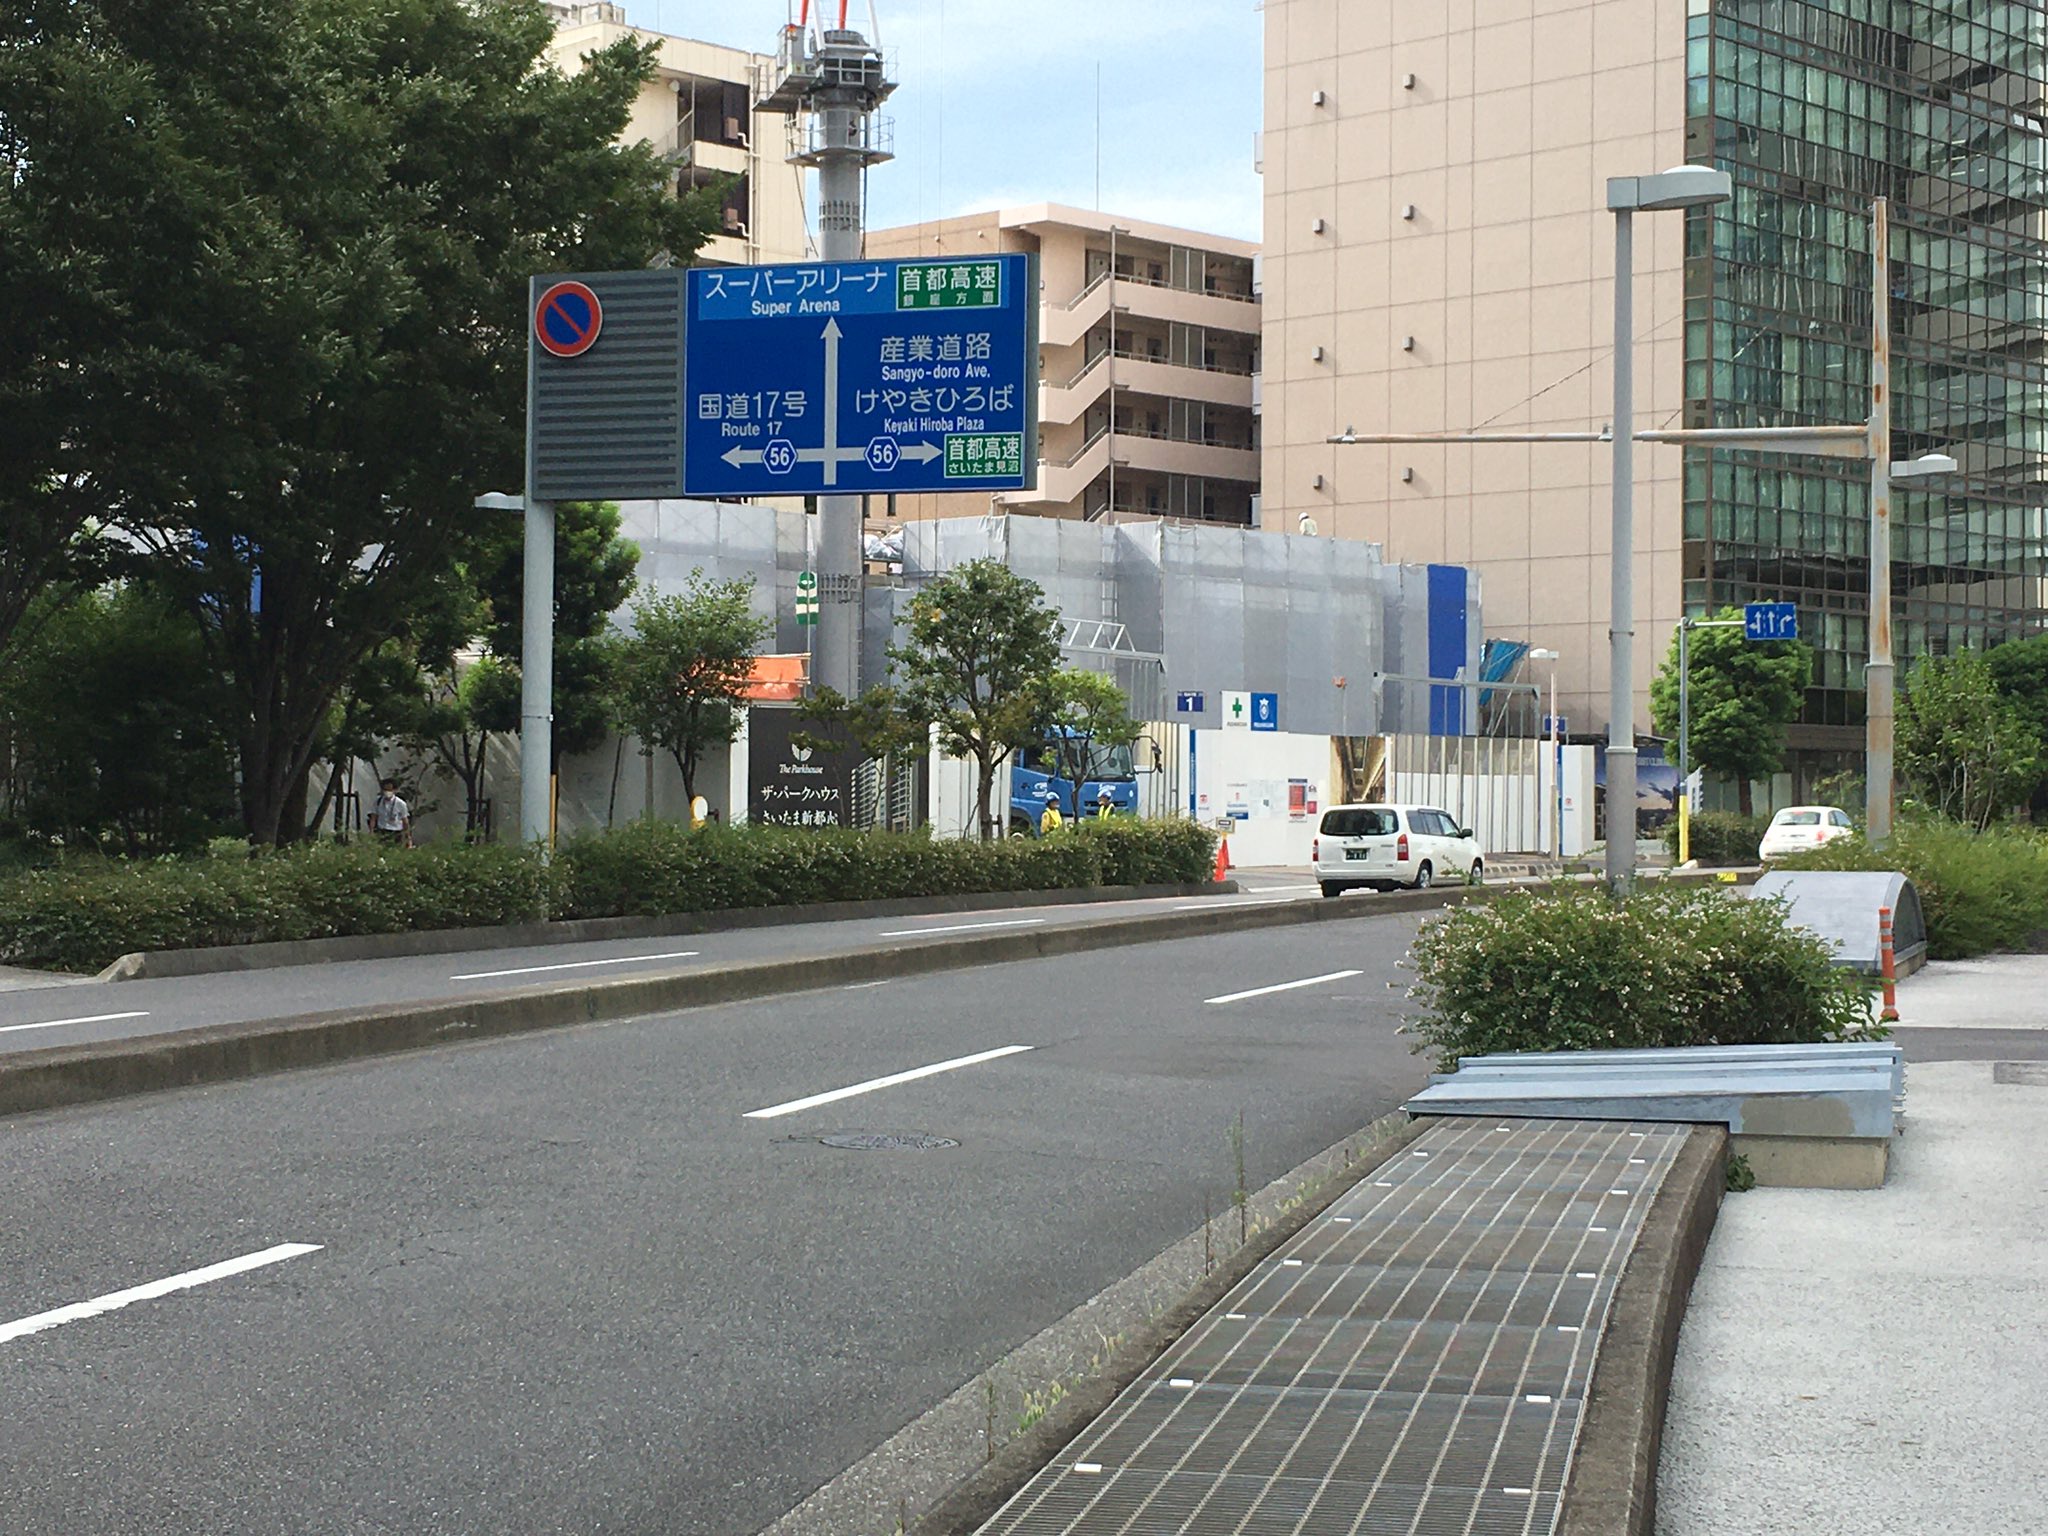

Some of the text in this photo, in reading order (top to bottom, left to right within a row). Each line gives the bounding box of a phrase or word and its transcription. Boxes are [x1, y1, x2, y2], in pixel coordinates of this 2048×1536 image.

[705, 266, 888, 299] スーパーアリーナ
[901, 265, 996, 292] 首都高速
[751, 298, 840, 317] Super Arena
[879, 332, 992, 363] 産業道路
[881, 363, 991, 383] Sangyo-doro Ave.
[698, 390, 808, 419] 国道17号
[855, 383, 1015, 414] けやきひろば
[721, 421, 783, 437] Route 17
[884, 416, 985, 435] Keyaki Hiroba Plaza
[769, 447, 790, 466] 56
[872, 444, 893, 464] 56
[948, 437, 1020, 461] 首都高速
[948, 460, 1019, 474] さいたま見沼
[1185, 697, 1193, 712] 1
[779, 764, 792, 774] The
[761, 784, 840, 801] ザ・パークハウス
[762, 810, 839, 826] さいたま新都心
